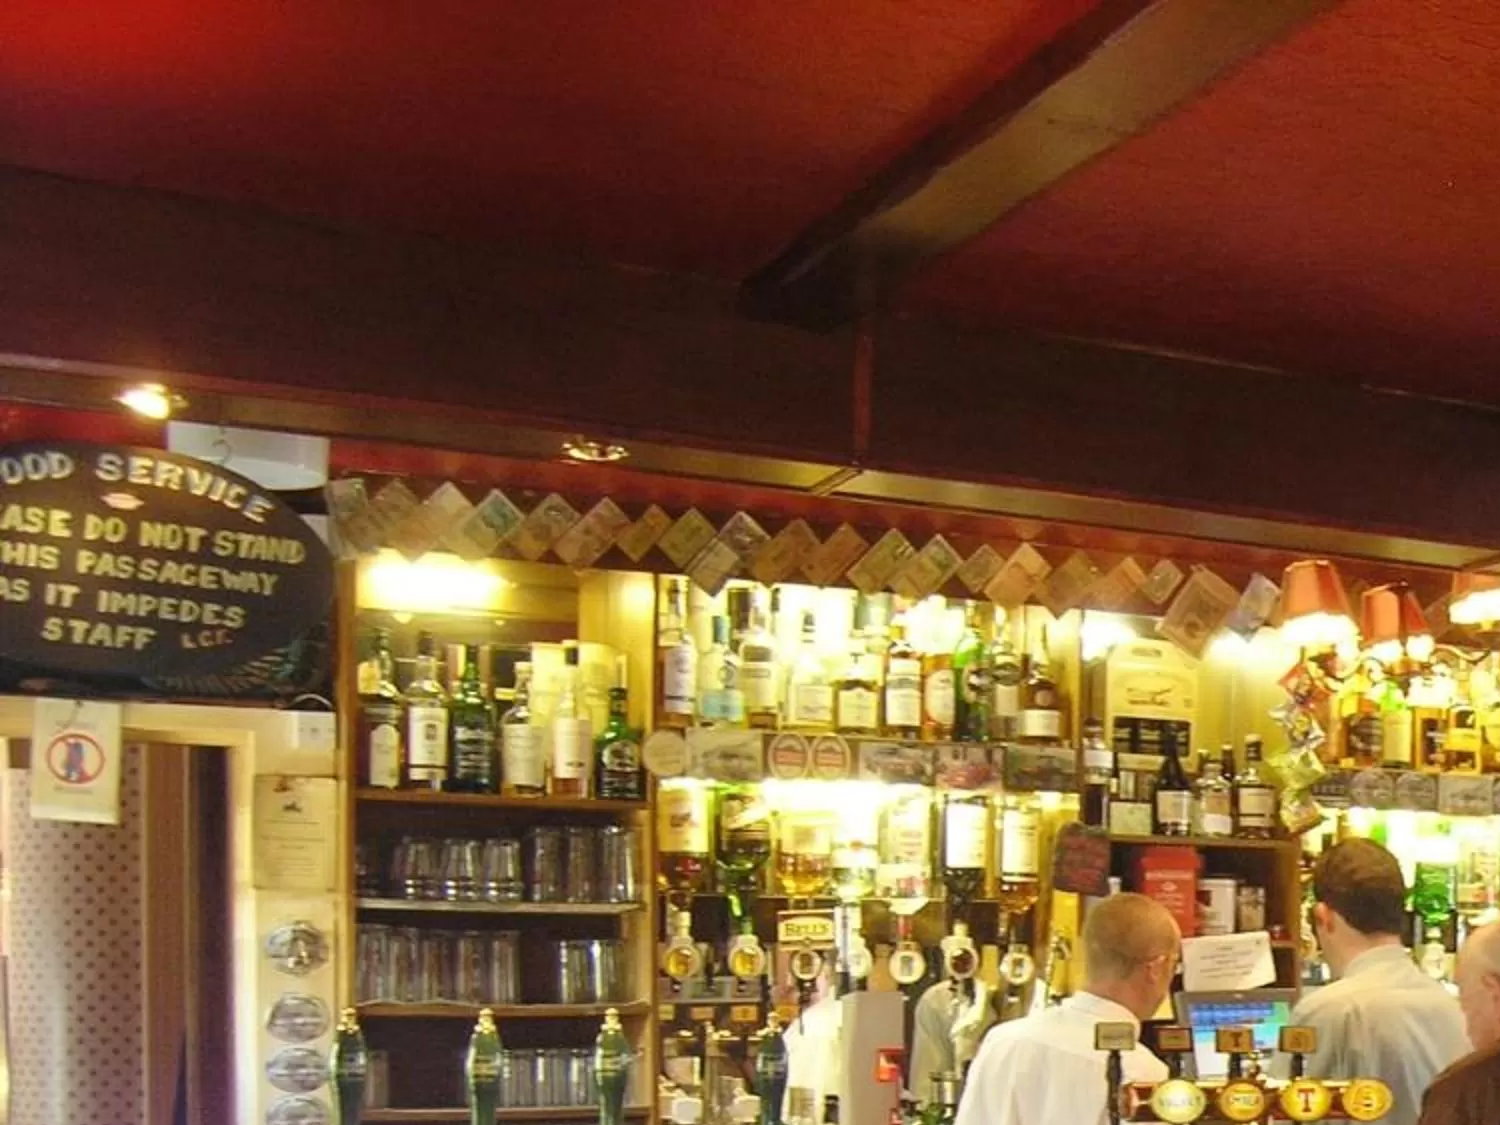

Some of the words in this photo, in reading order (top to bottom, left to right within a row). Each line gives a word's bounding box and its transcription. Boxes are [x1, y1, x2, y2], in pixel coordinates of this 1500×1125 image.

[94, 452, 275, 523] SERVICE
[83, 513, 127, 543] DO
[139, 520, 209, 553] NOT
[213, 530, 305, 565] STAND
[0, 540, 61, 571] HIS
[76, 549, 278, 596] PASSAGEWAY
[45, 582, 80, 608] IT
[97, 589, 247, 629] IMPEDES
[40, 616, 157, 651] STAFF
